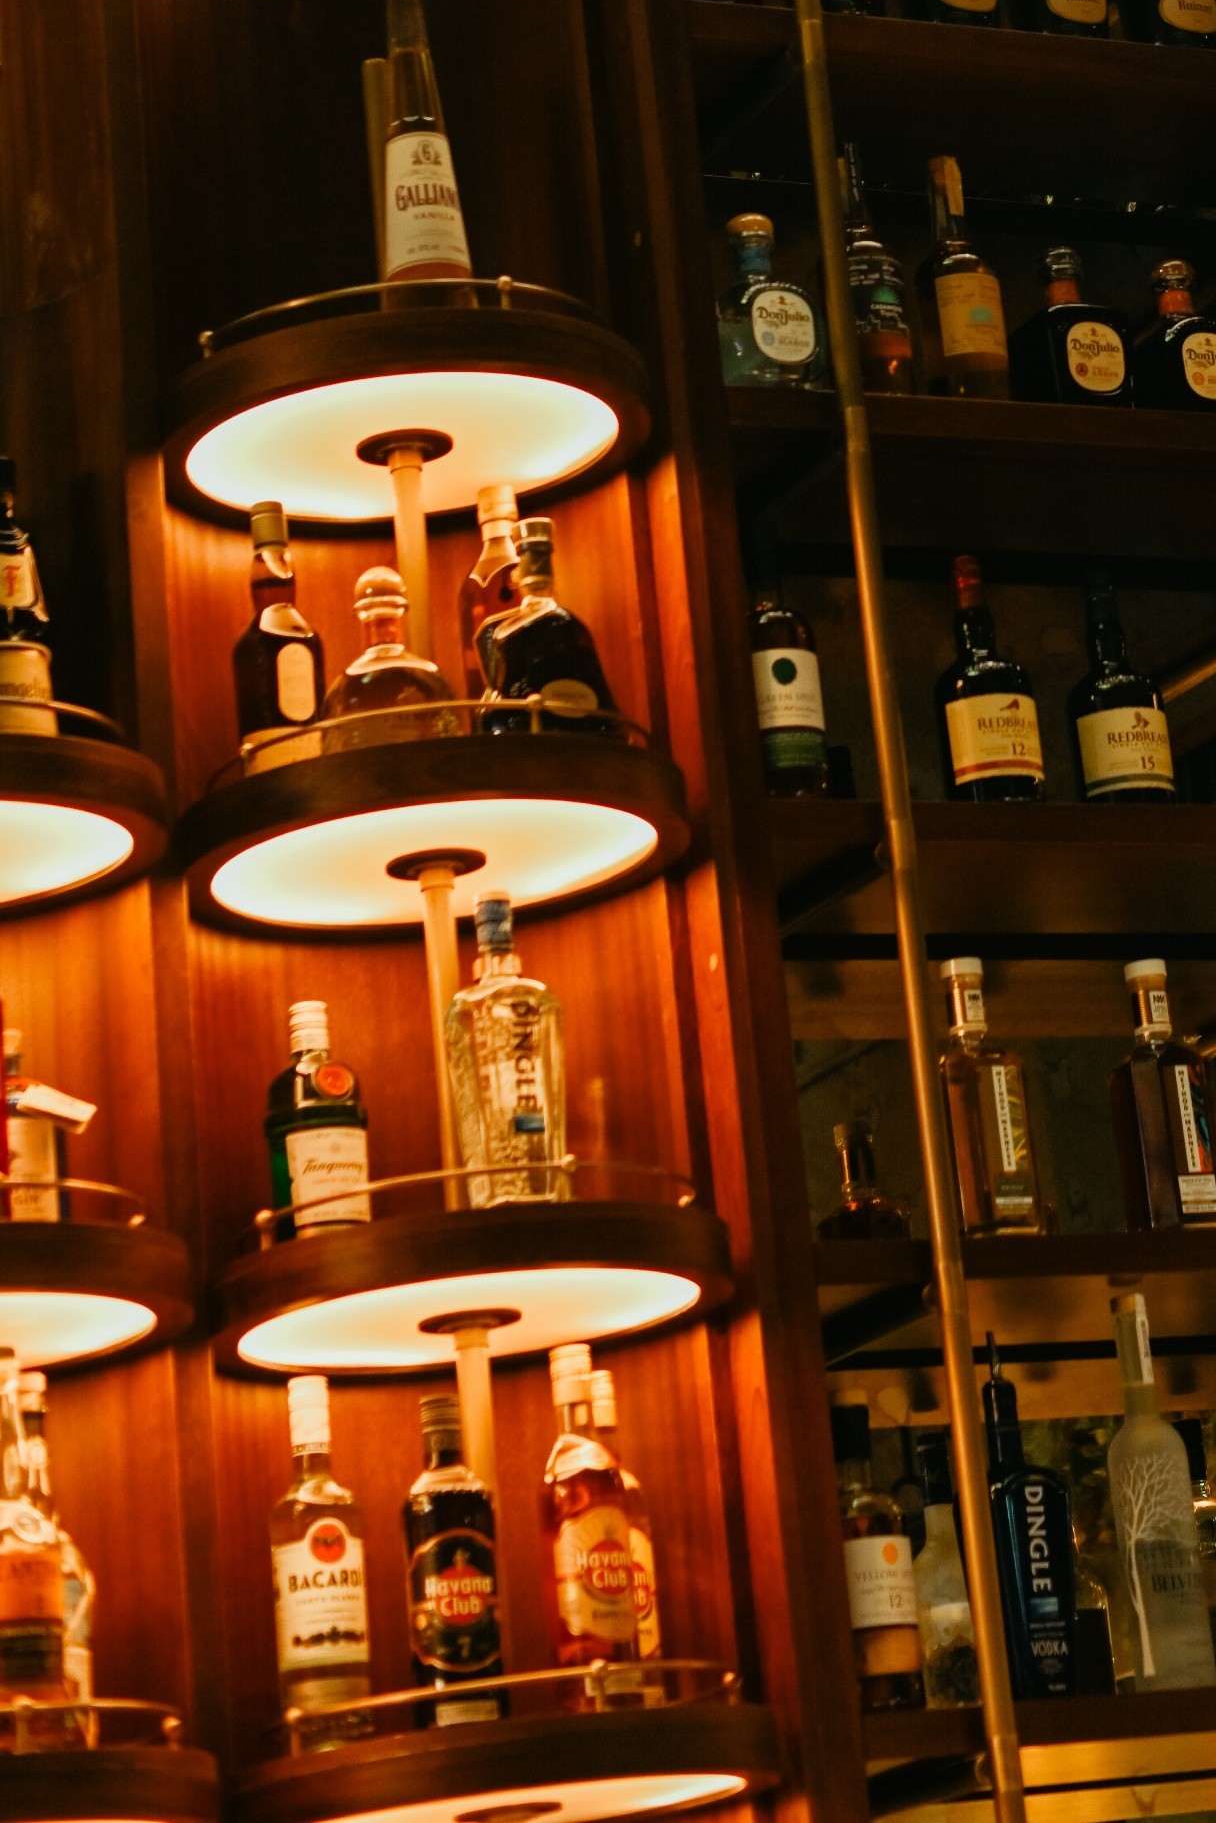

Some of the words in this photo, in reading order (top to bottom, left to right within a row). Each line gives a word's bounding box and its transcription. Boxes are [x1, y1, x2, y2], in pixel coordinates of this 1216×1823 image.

[1011, 742, 1026, 757] 12
[1140, 756, 1156, 770] 15
[1024, 1485, 1052, 1593] DINGLE
[425, 1574, 493, 1599] Havana
[592, 1569, 628, 1589] Club
[440, 1595, 483, 1617] Club
[1031, 1640, 1069, 1657] VODKA
